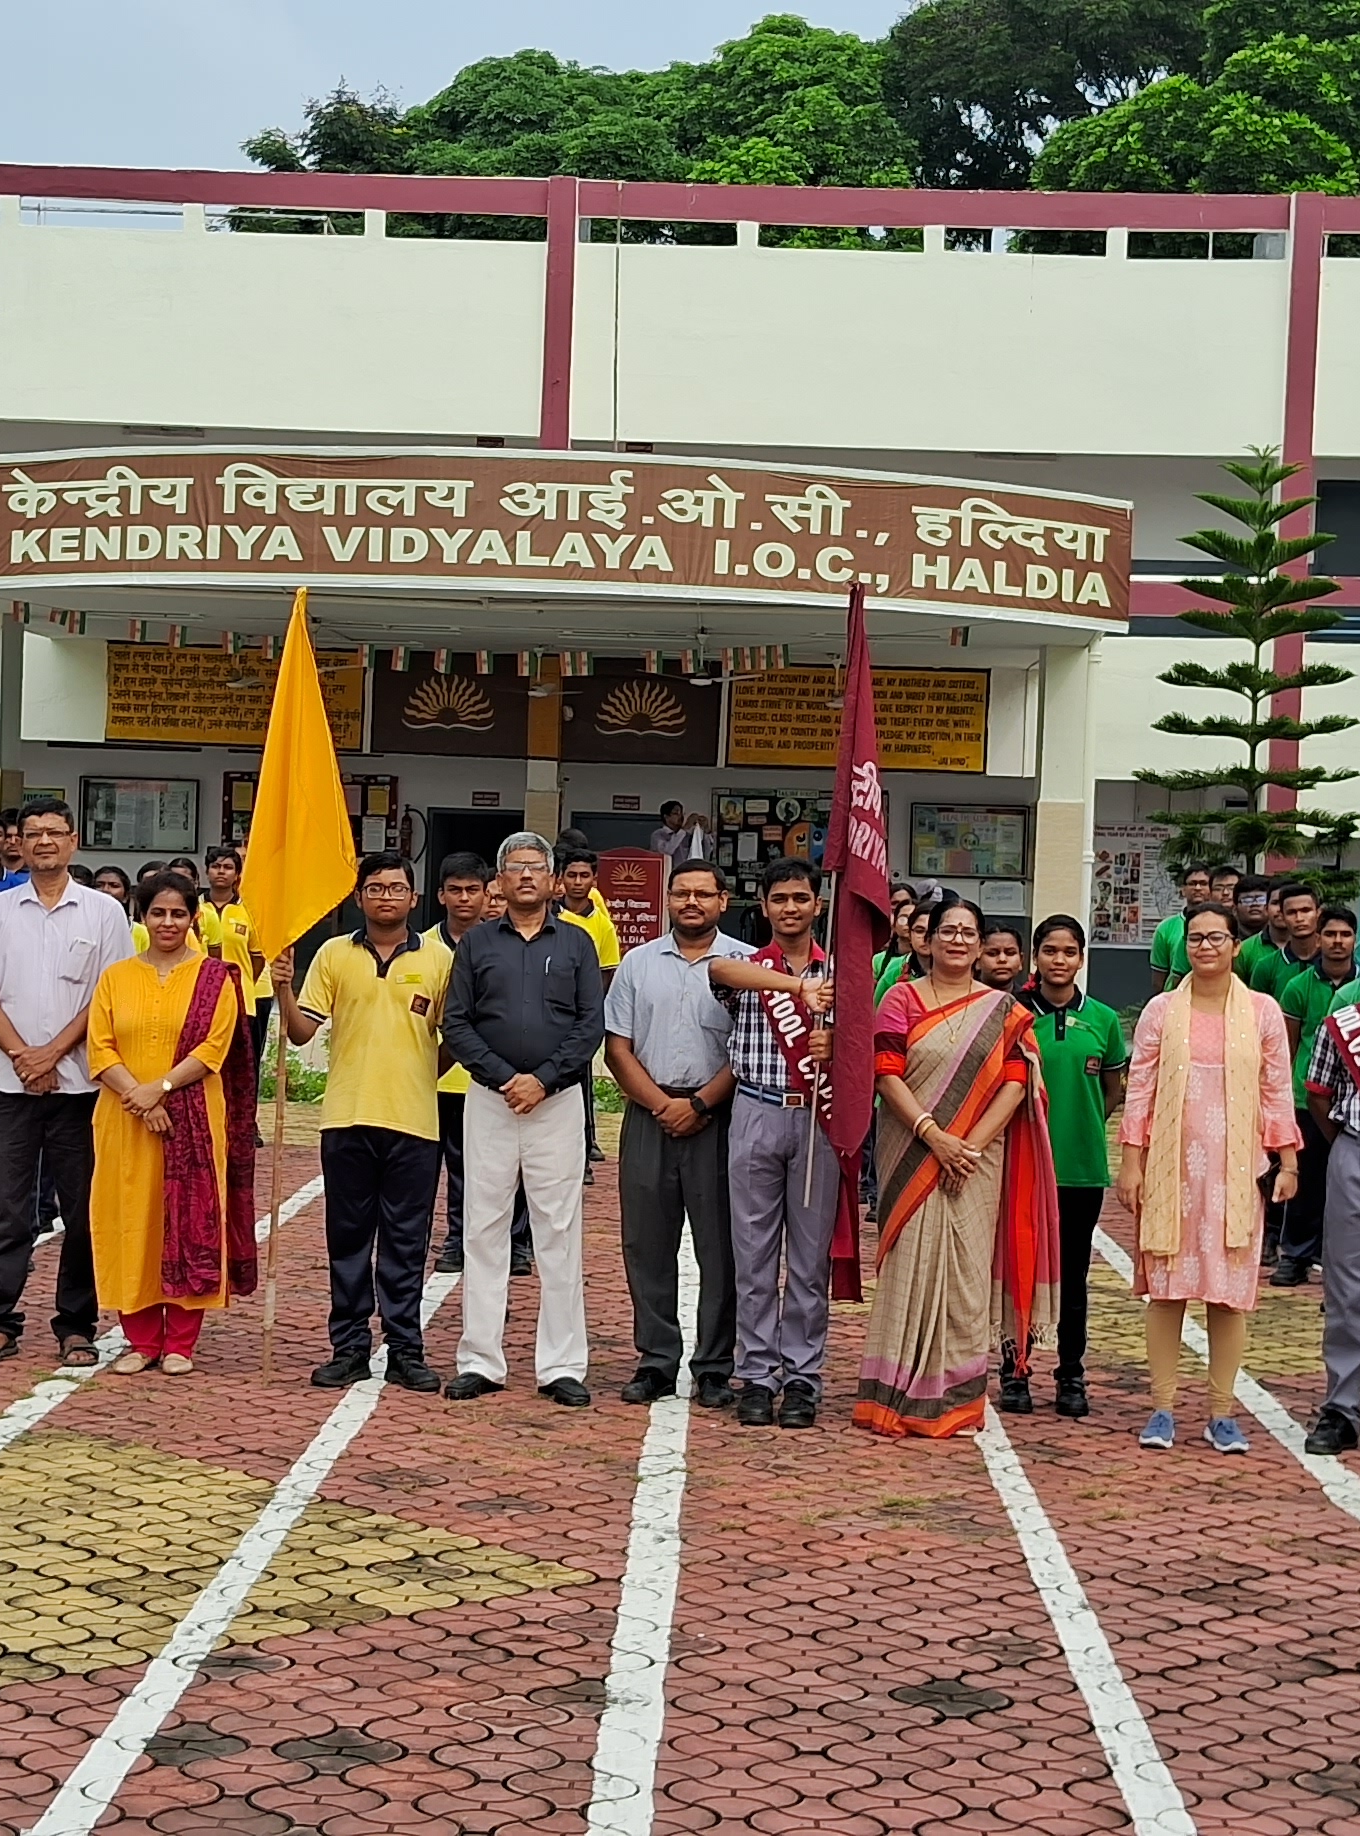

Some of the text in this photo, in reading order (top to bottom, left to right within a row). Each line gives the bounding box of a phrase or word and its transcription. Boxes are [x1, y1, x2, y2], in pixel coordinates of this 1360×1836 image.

[1, 465, 195, 519] केन्द्रीय
[215, 462, 475, 518] विद्यालय
[911, 497, 1111, 563] हल्दिया
[9, 524, 1112, 608] KENDRIYA VIDYALAYA I.O.C., HALDIA
[767, 674, 778, 683] MY
[780, 674, 810, 684] COUNTRY
[812, 675, 825, 685] AND
[886, 678, 896, 687] MY
[898, 678, 930, 688] BROTHERS
[932, 679, 945, 688] AND
[738, 686, 755, 695] LOVE
[756, 687, 766, 695] MY
[767, 687, 796, 696] COUNTRY
[797, 688, 810, 697] AND
[815, 689, 825, 697] AM
[889, 691, 903, 700] AND
[735, 699, 759, 708] ALWAYS
[761, 700, 781, 709] STRIVE
[785, 700, 793, 709] TO
[795, 701, 804, 710] BE
[880, 704, 893, 712] GIVE
[895, 704, 923, 714] RESPECT
[926, 705, 934, 714] TO
[935, 706, 944, 714] MY
[913, 718, 933, 727] EVERY
[936, 719, 950, 727] ONE
[768, 726, 777, 736] TO
[780, 727, 788, 736] MY
[791, 727, 817, 737] COUNTRY
[820, 728, 833, 737] AND
[879, 730, 904, 739] PLEDGE
[906, 731, 916, 740] MY
[964, 733, 982, 742] THEIR
[734, 738, 752, 748] WELL
[755, 739, 774, 749] BEING
[777, 740, 791, 749] AND
[793, 741, 835, 751] PROSPERITY
[882, 743, 892, 752] MY
[623, 925, 650, 934] I.O.C.
